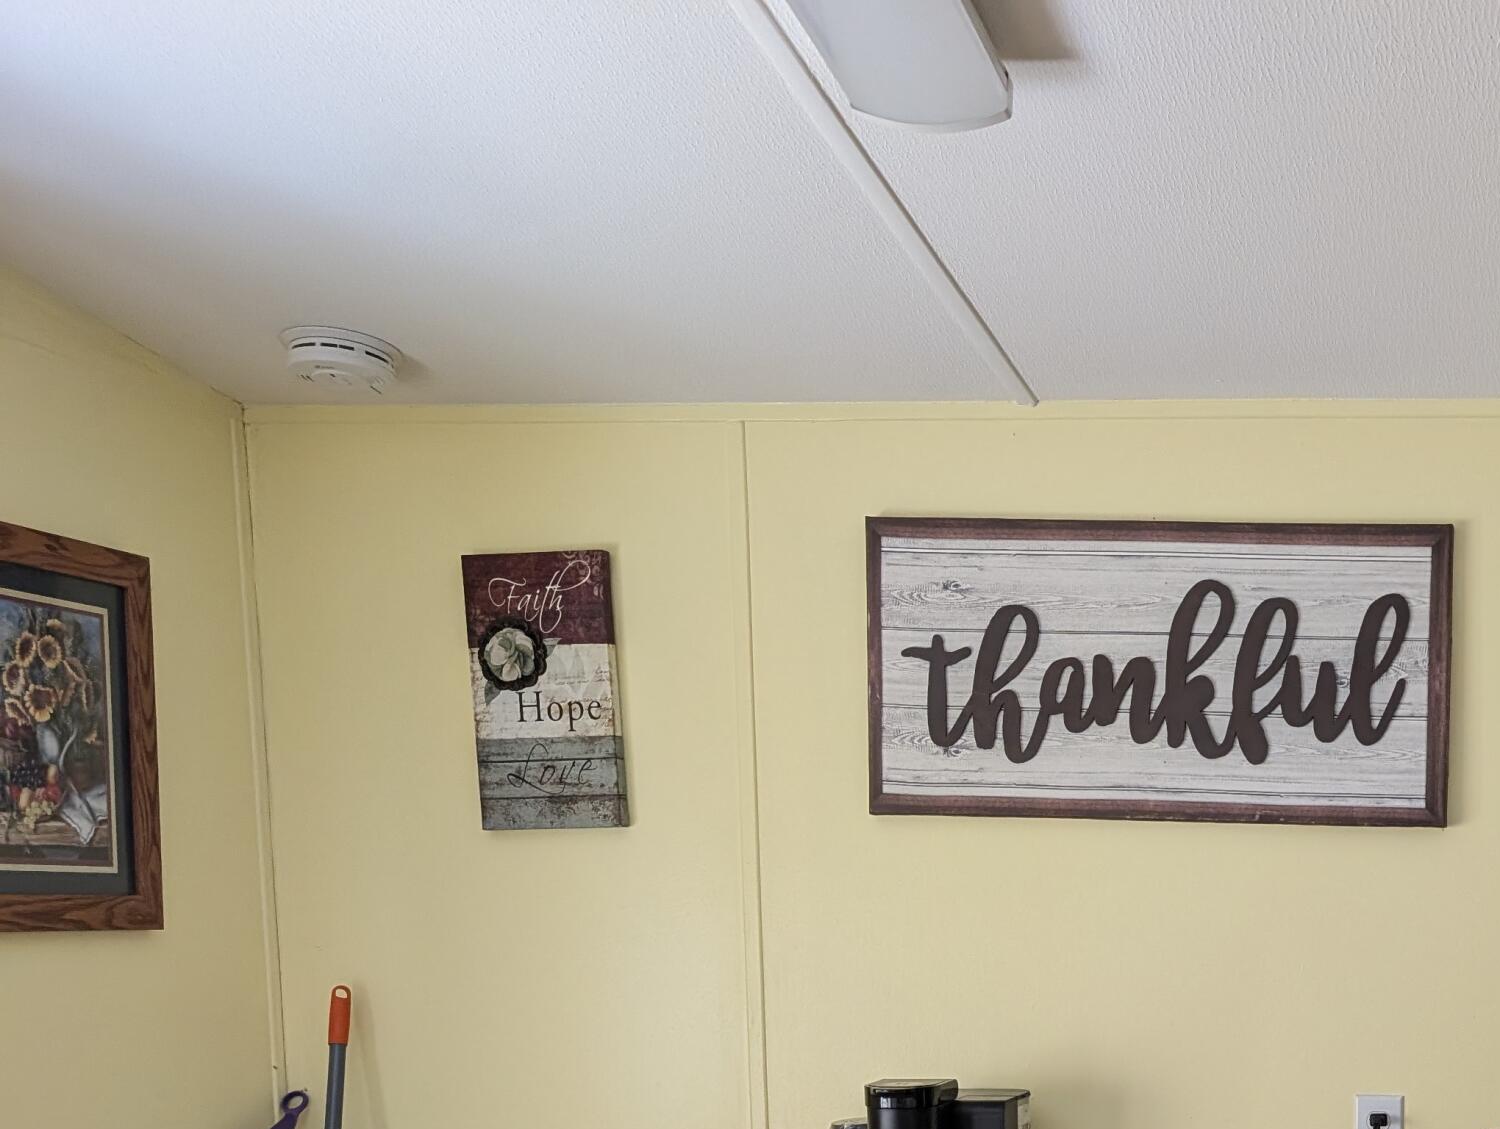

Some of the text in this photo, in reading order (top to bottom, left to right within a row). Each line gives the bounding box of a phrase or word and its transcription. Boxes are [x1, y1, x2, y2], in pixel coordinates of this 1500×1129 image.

[488, 560, 591, 633] Faith
[901, 579, 1410, 765] thankful
[515, 691, 602, 731] Hope
[507, 743, 598, 794] Love
